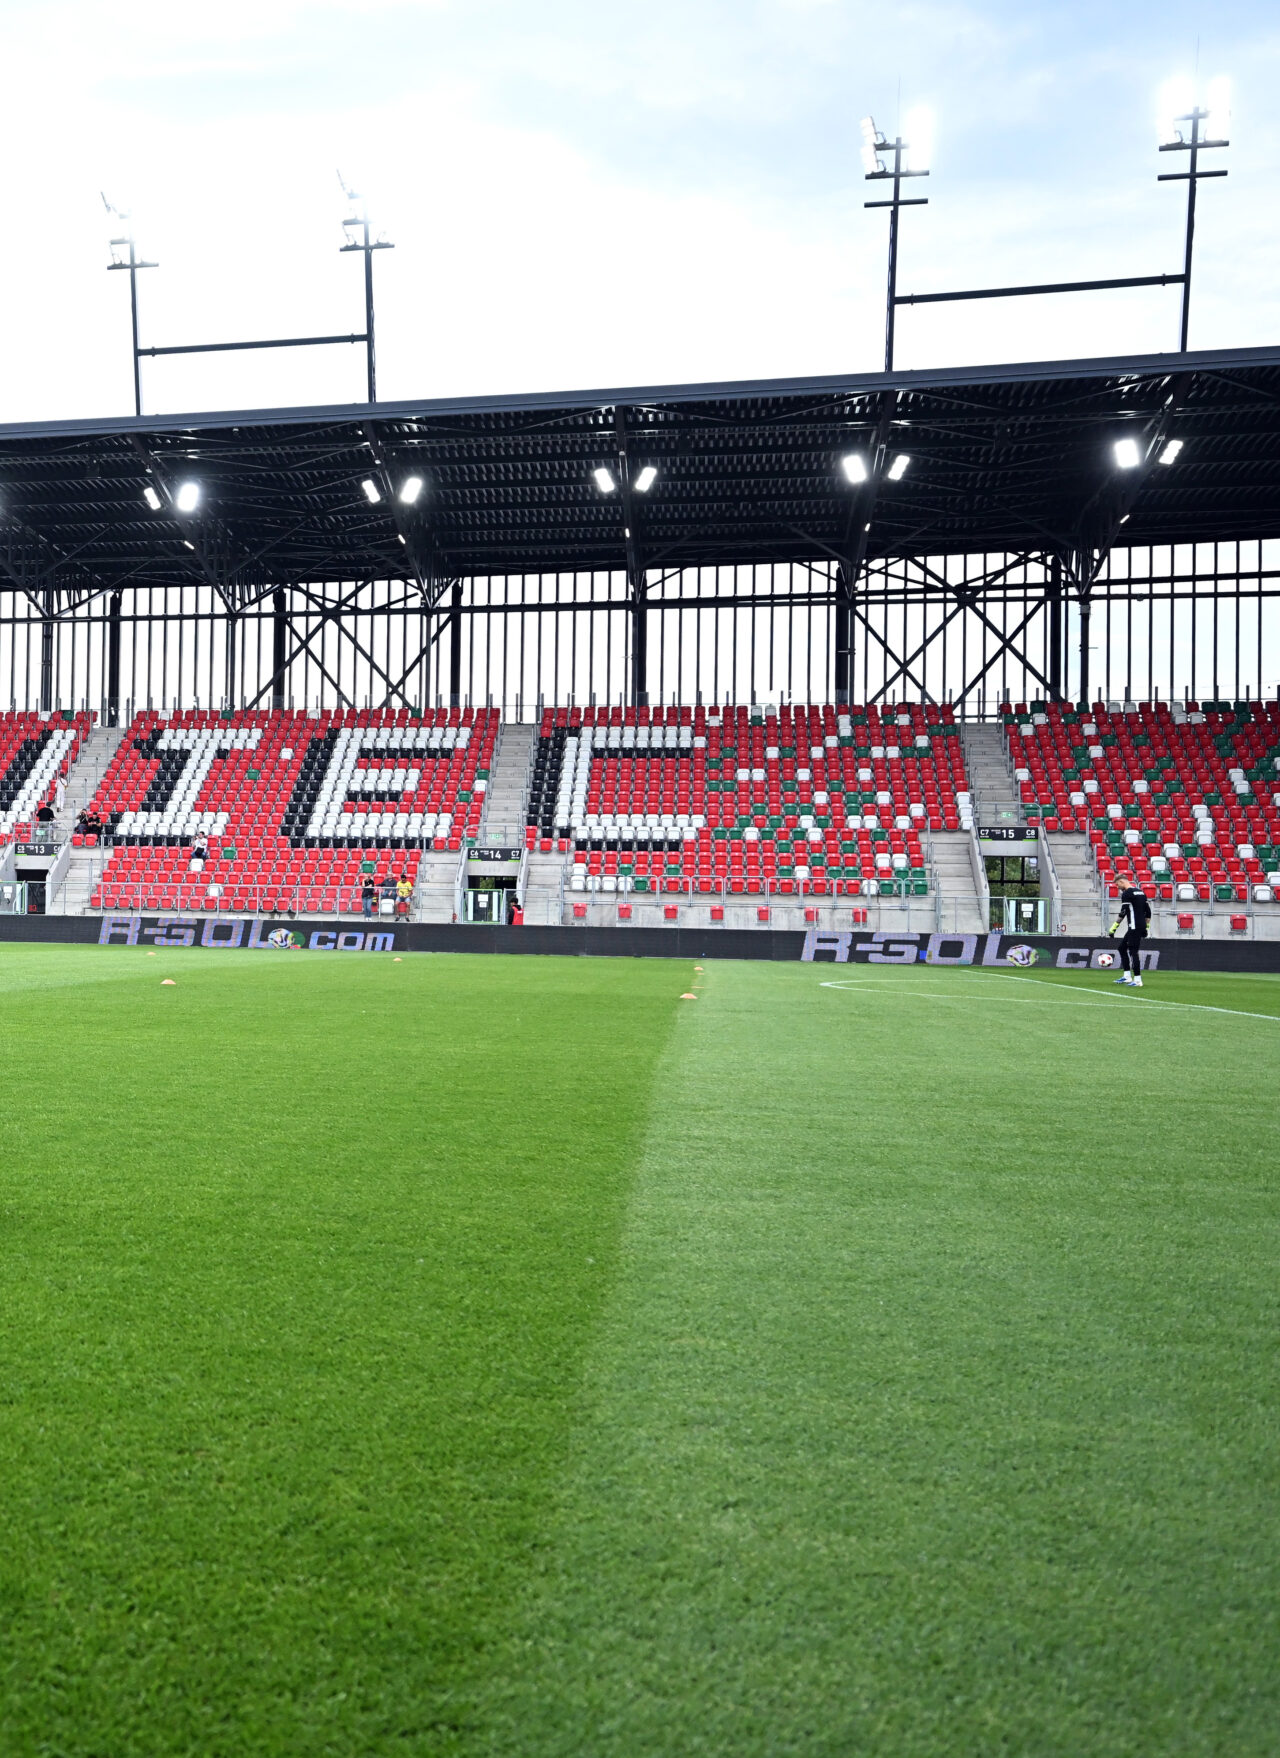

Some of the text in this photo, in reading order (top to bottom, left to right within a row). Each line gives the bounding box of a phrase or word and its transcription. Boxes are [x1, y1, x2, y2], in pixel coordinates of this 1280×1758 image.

[1001, 829, 1015, 839] 15
[34, 845, 45, 854] 13
[489, 850, 502, 859] 14
